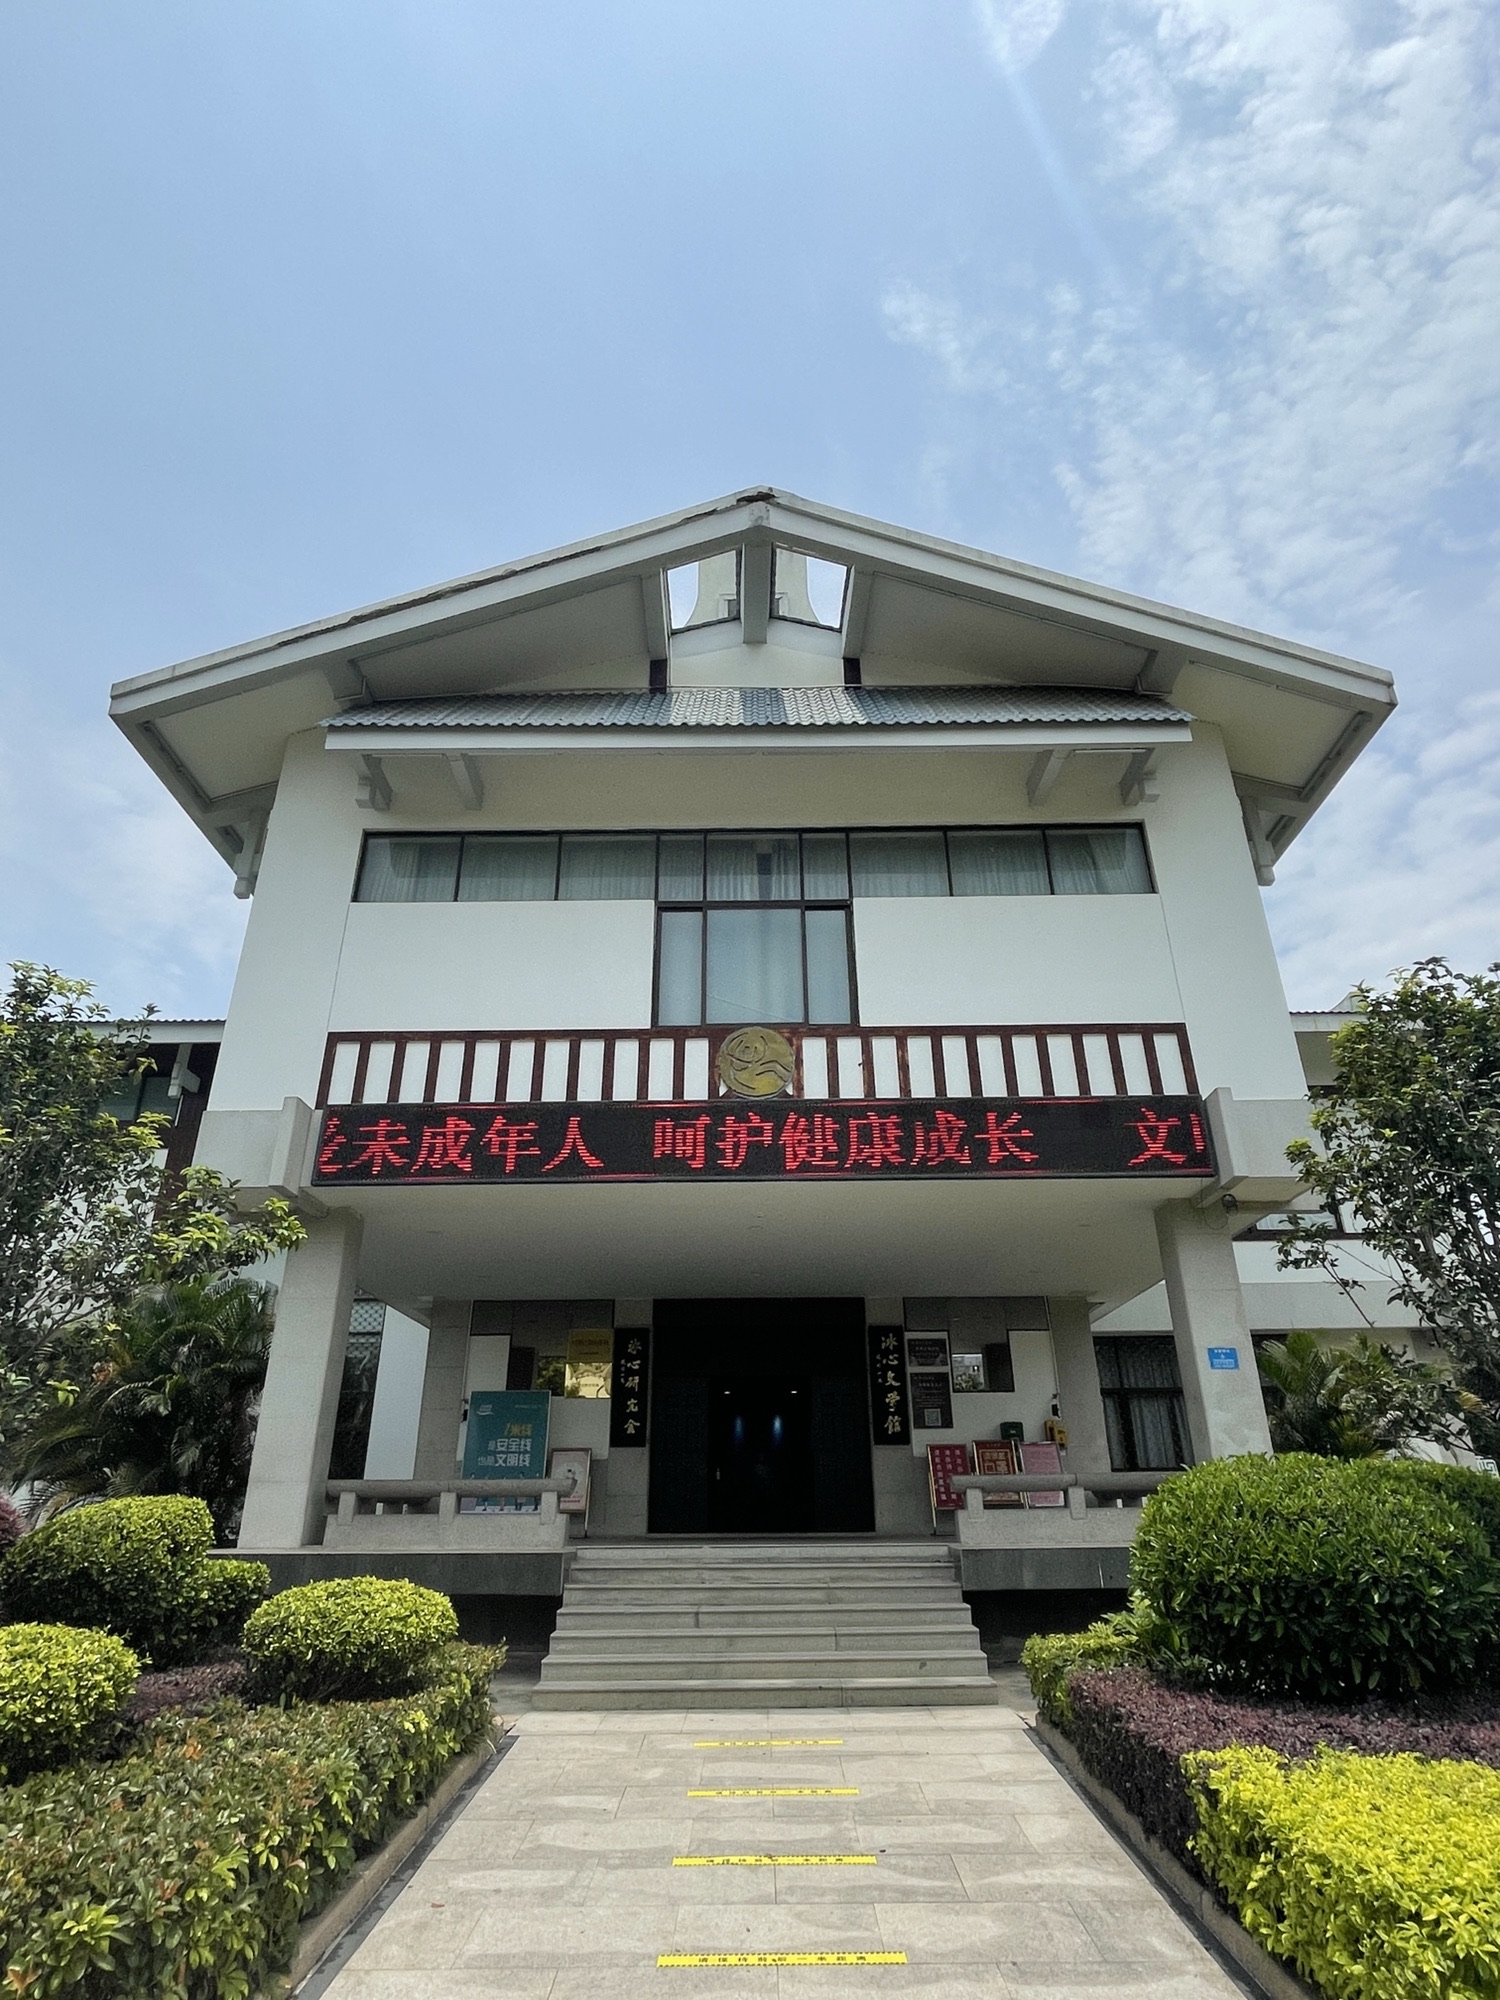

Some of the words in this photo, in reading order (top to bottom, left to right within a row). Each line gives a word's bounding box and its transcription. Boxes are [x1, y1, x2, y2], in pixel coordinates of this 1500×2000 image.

[653, 1110, 1040, 1170] 呵护健康成长
